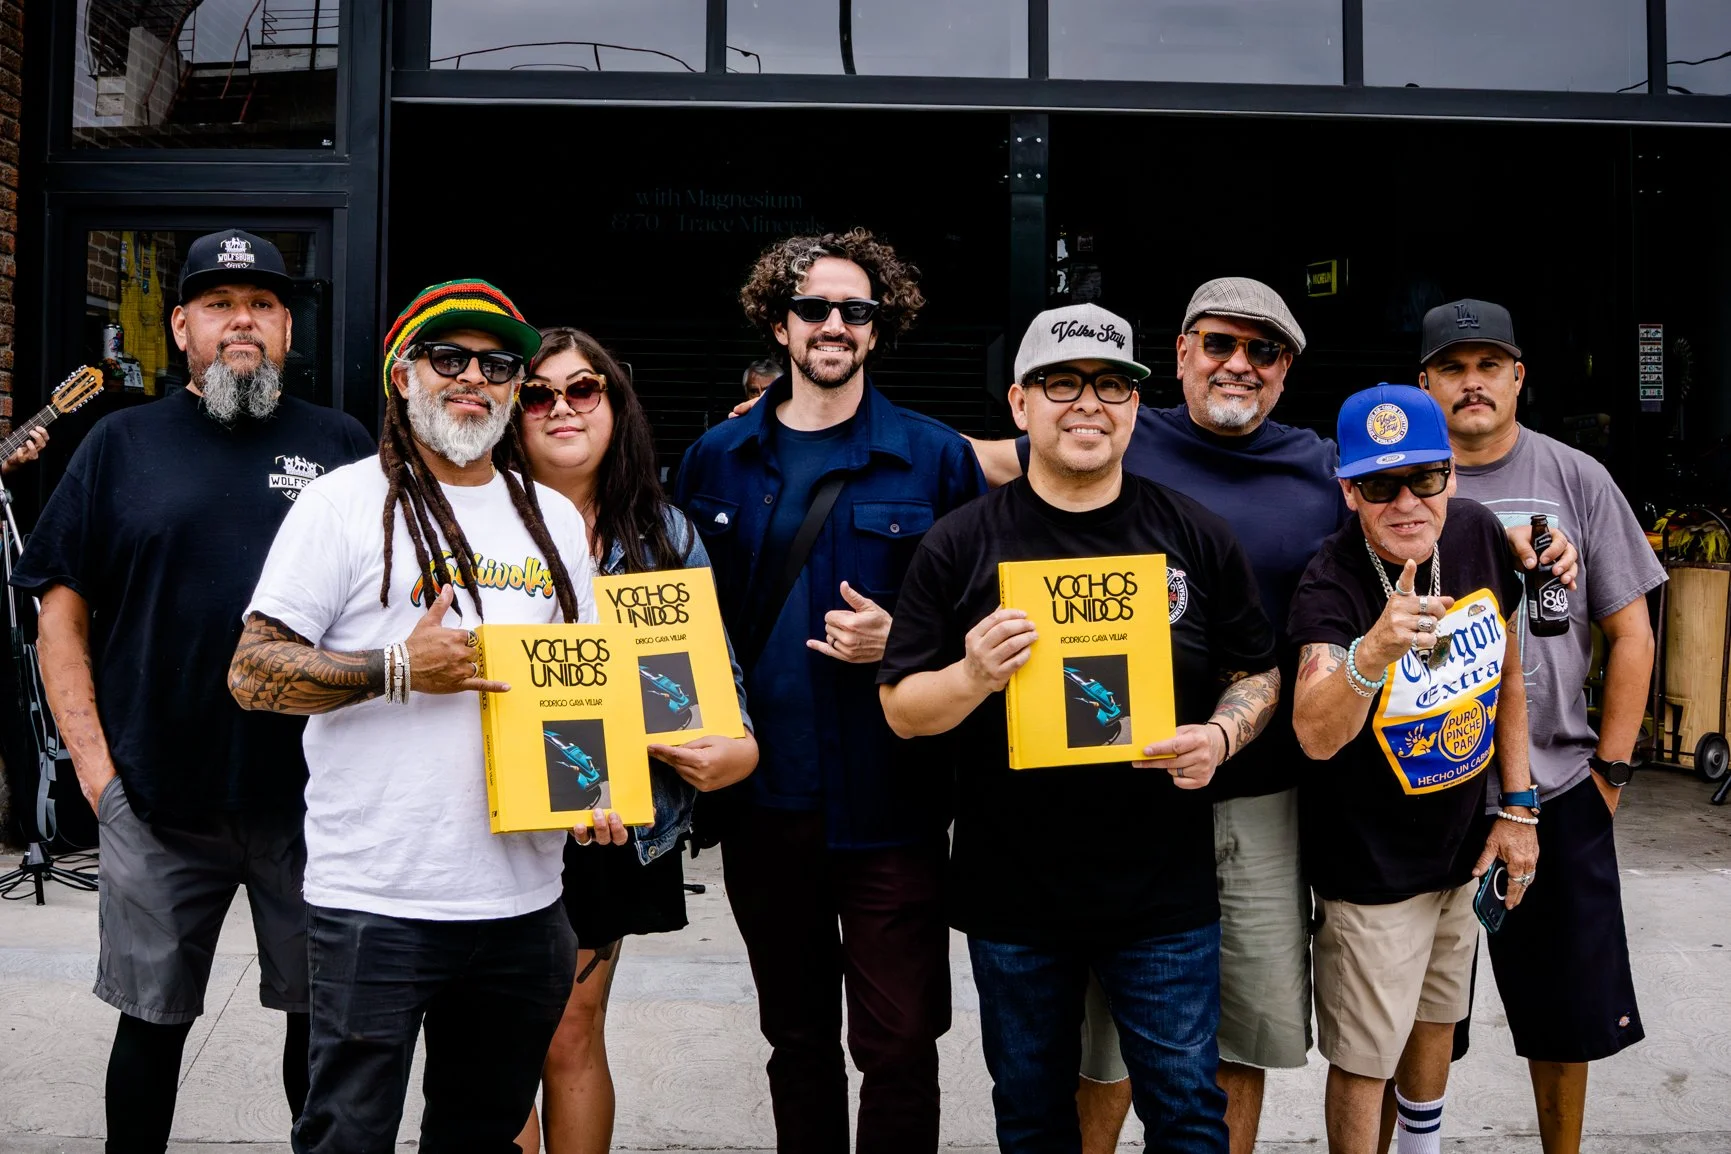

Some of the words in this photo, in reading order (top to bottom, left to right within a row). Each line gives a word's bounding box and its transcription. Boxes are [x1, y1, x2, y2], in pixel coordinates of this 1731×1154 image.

[635, 187, 681, 206] with
[686, 188, 804, 210] Magnesium
[676, 213, 734, 232] Trace
[740, 214, 825, 235] Minerals
[1454, 303, 1480, 330] LA
[1051, 320, 1097, 343] Volks
[605, 582, 690, 608] VOCHOS
[1043, 571, 1138, 600] VOCHOS
[1169, 580, 1187, 621] ANNIVERSARY
[1543, 588, 1567, 608] 80
[615, 603, 690, 628] UNIDOS
[1052, 597, 1134, 624] UNIDOS
[655, 635, 670, 643] GAYA
[670, 633, 687, 642] VILLAR
[1060, 634, 1090, 644] RODRIGO
[1091, 634, 1108, 643] GAYA
[1109, 632, 1128, 641] VILLAR
[521, 638, 611, 663] VOCHOS
[530, 663, 608, 688] UNIDOS
[1416, 660, 1500, 708] Extra
[539, 699, 568, 708] RODRIGO
[569, 699, 585, 707] GAYA
[586, 698, 603, 707] VILLAR
[1446, 718, 1481, 742] PINCHE
[1448, 707, 1478, 730] PURO
[1453, 733, 1476, 753] PARI
[1417, 770, 1455, 786] HECHO
[1456, 762, 1469, 775] UN
